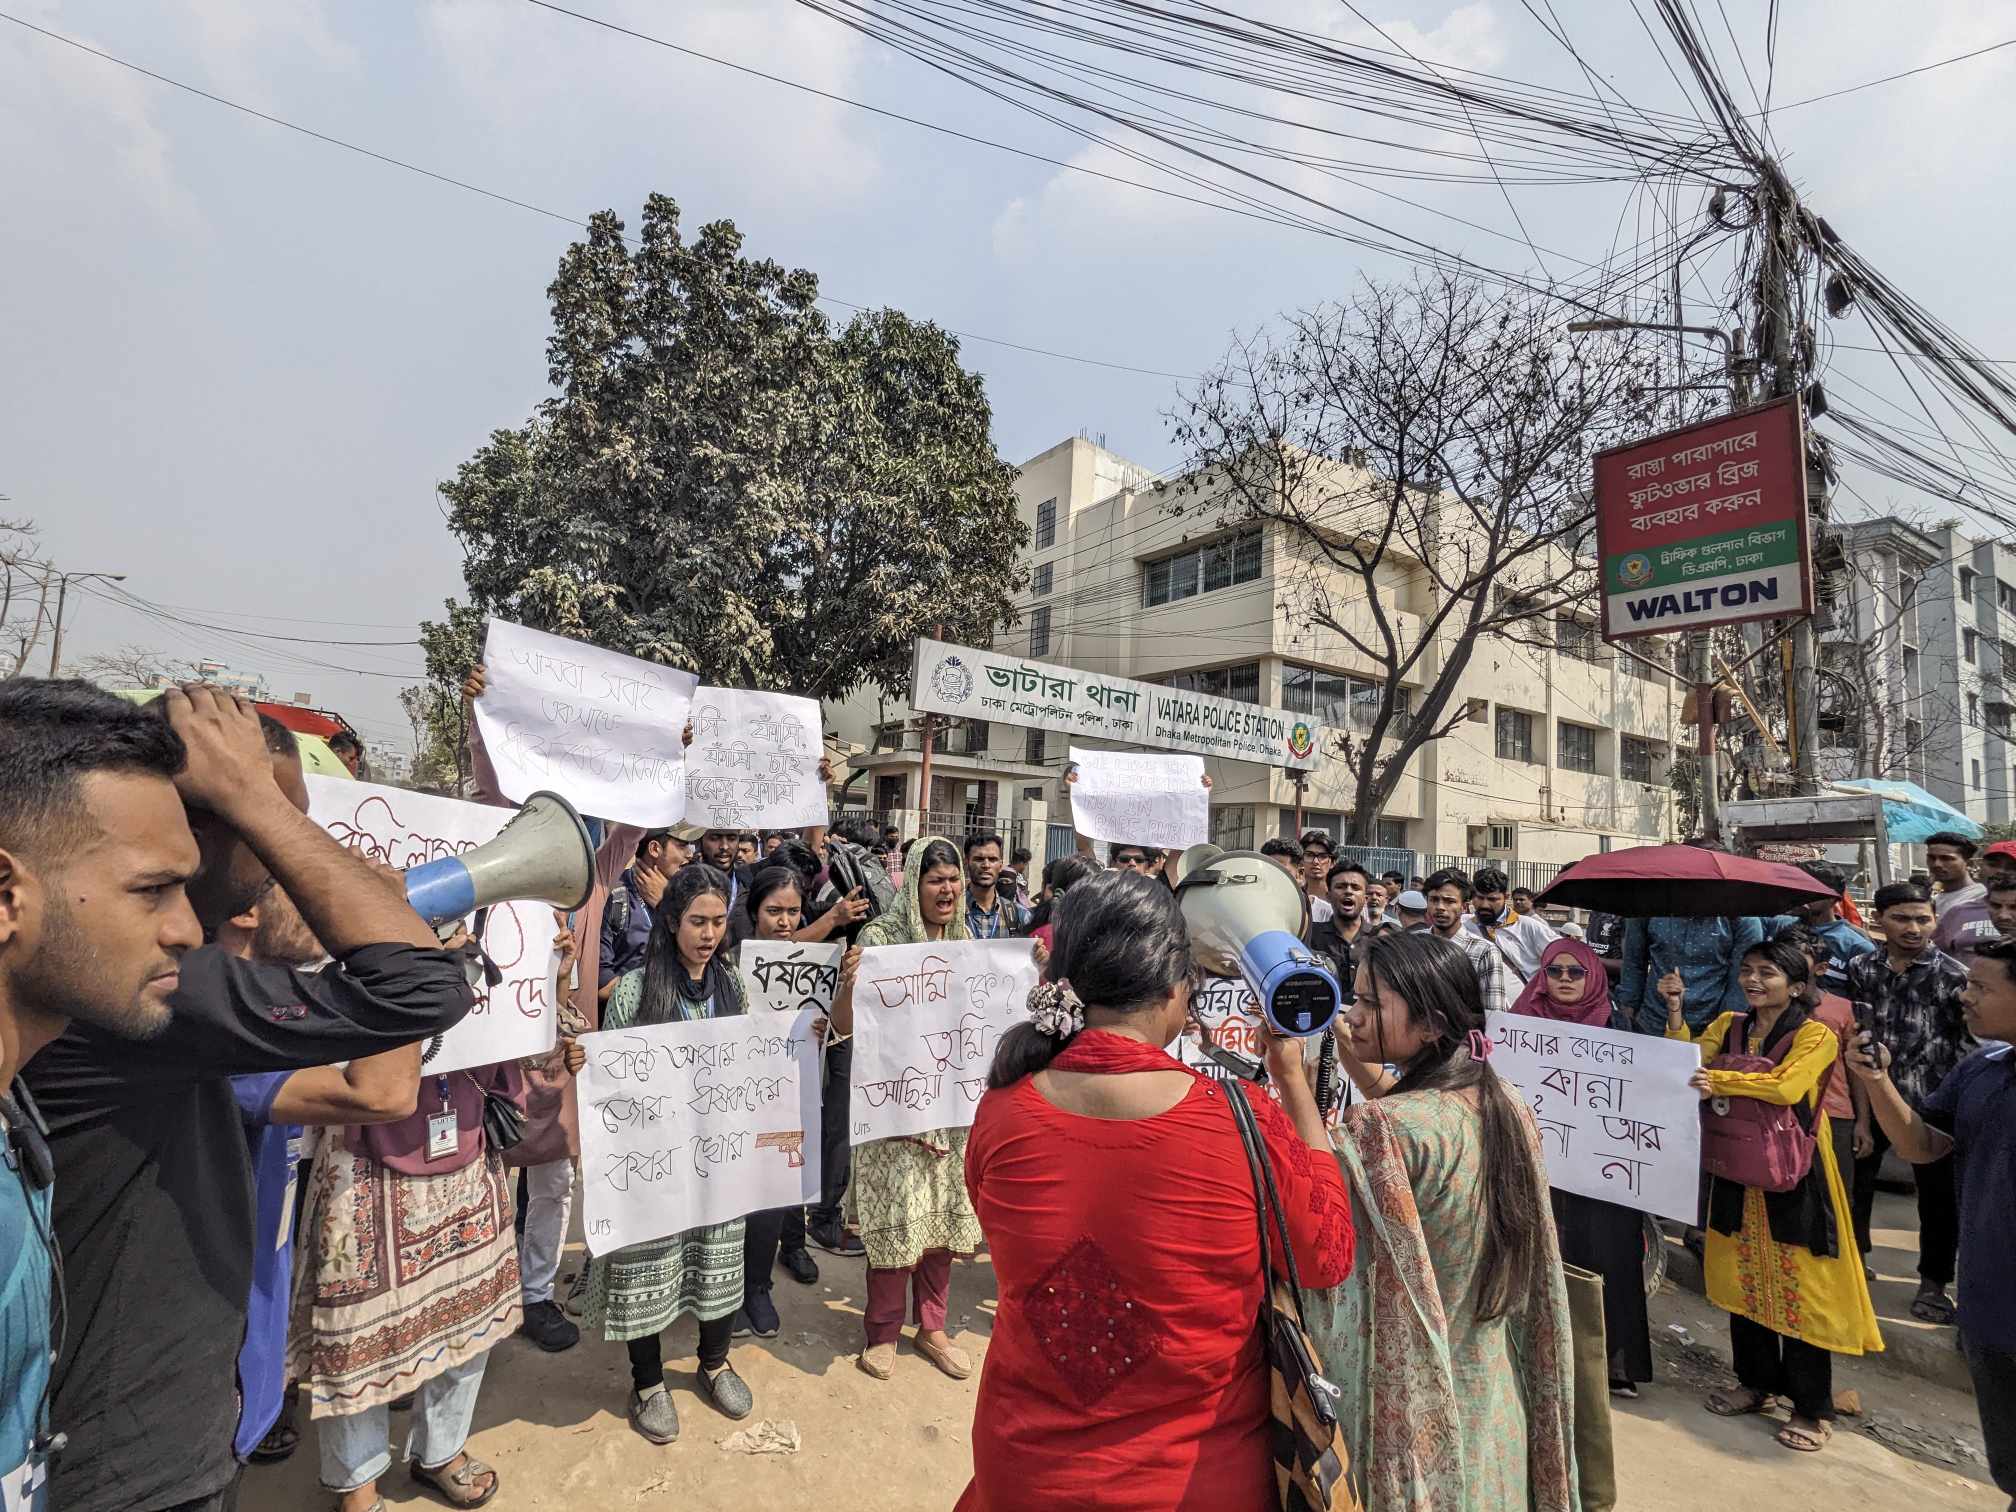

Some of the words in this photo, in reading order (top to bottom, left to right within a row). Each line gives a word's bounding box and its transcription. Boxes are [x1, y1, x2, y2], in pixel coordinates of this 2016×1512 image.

[1626, 455, 1666, 481] রাস্তা
[1671, 430, 1758, 467] পারাপারে
[1628, 470, 1712, 511] ফুটওভার
[1716, 458, 1760, 486] ব্রিজ
[1631, 504, 1699, 532] ব্যবহার
[1704, 488, 1762, 517] করুন
[1748, 529, 1786, 547] বিভাগ
[1626, 577, 1778, 621] WALTON
[980, 695, 1007, 711] ঢাকা
[1009, 701, 1074, 721] মেট্রোপলিটন
[984, 663, 1079, 702] ভাটারা
[1086, 679, 1142, 713] থানা
[1155, 726, 1181, 740] Dhaka
[1183, 730, 1231, 749] Metropolitan
[1157, 697, 1201, 727] VATARA
[1202, 705, 1242, 734] POLICE
[1243, 713, 1285, 741] STATION
[752, 948, 838, 1001] ধর্ষকের
[868, 955, 955, 1008] আমি
[920, 1012, 995, 1072] তুমি
[1494, 1027, 1561, 1056] আমার
[1568, 1036, 1634, 1065] বোনের
[1539, 1065, 1633, 1113] কান্না
[1596, 1114, 1666, 1152] আর
[1593, 1152, 1654, 1196] না
